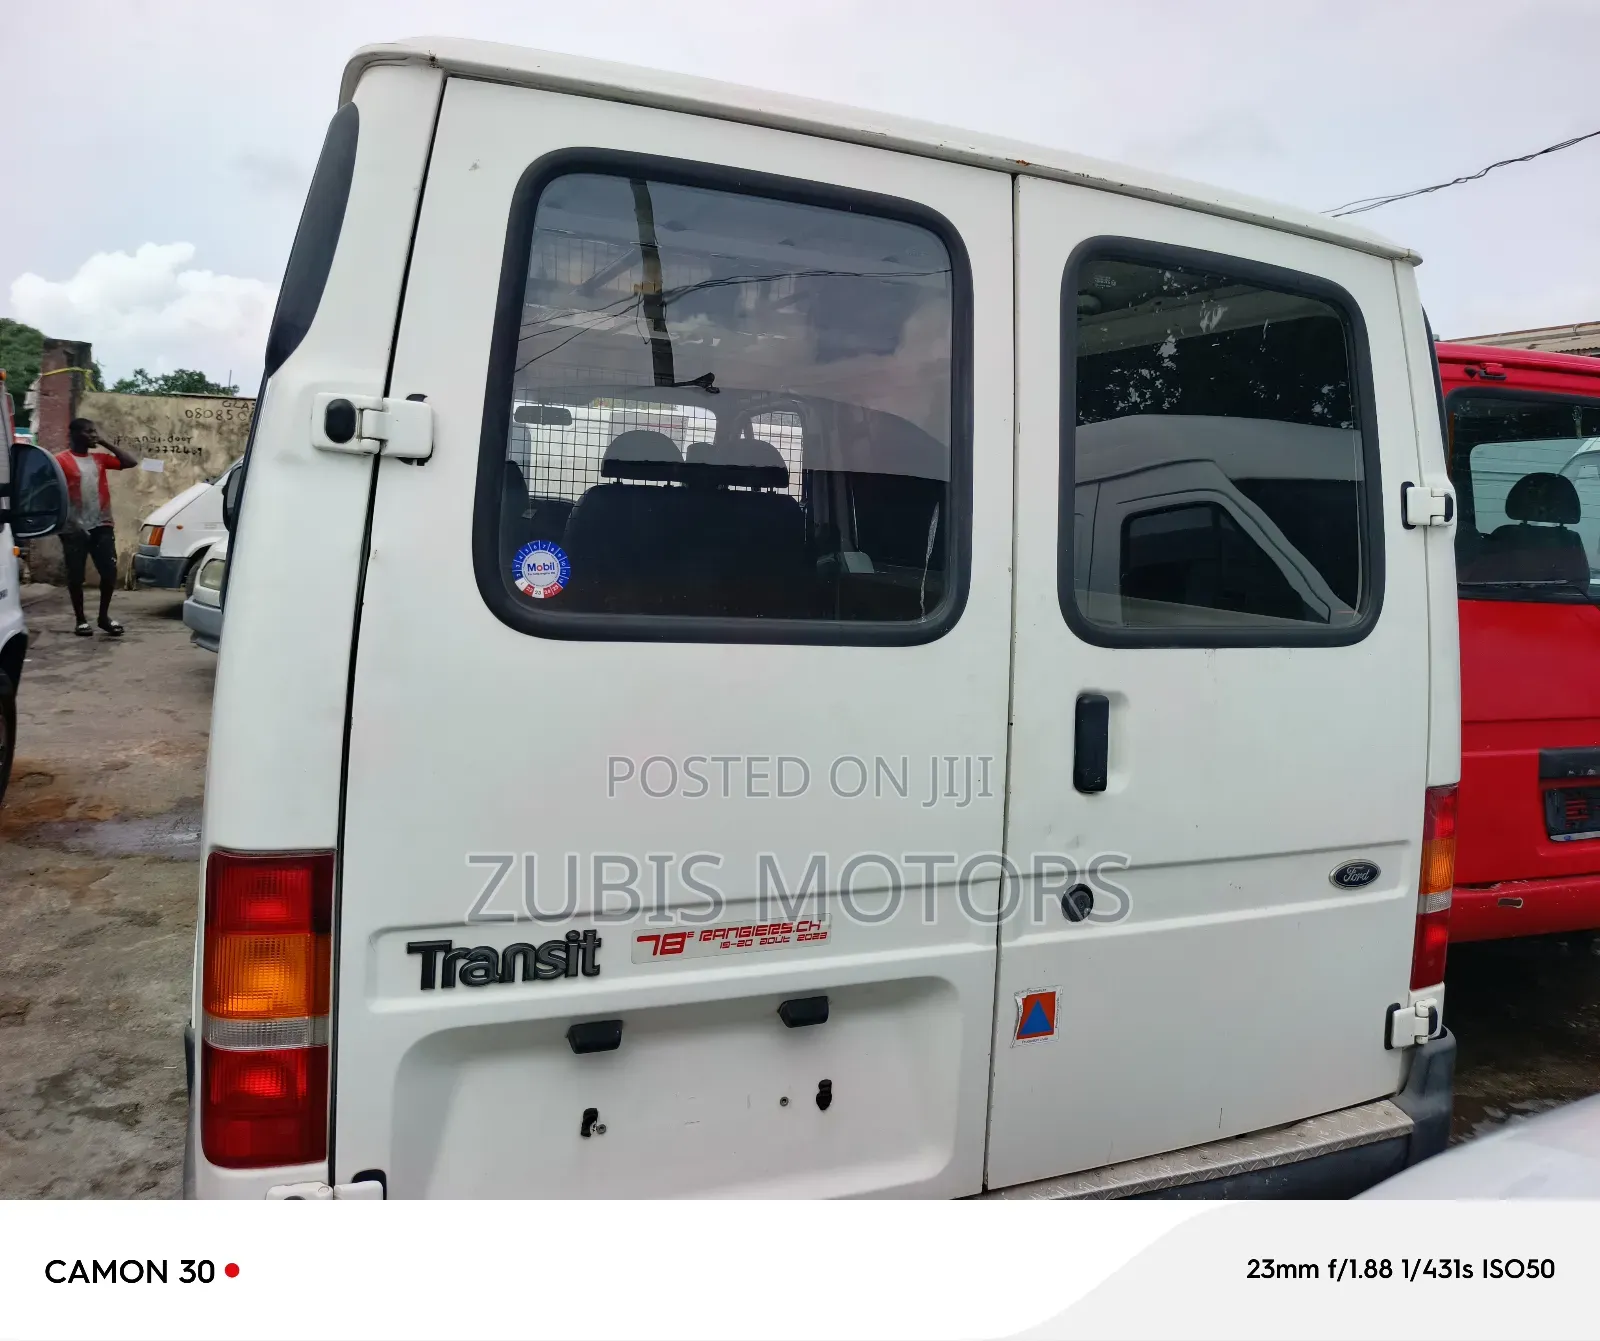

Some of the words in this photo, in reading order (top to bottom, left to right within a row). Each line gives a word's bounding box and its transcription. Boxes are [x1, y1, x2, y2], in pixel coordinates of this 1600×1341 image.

[527, 562, 555, 572] Mobil
[1343, 866, 1370, 882] Ford
[698, 919, 822, 942] RANGIERS.CH
[719, 939, 754, 950] 19-20
[796, 931, 828, 942] 2023
[407, 929, 603, 991] Transit
